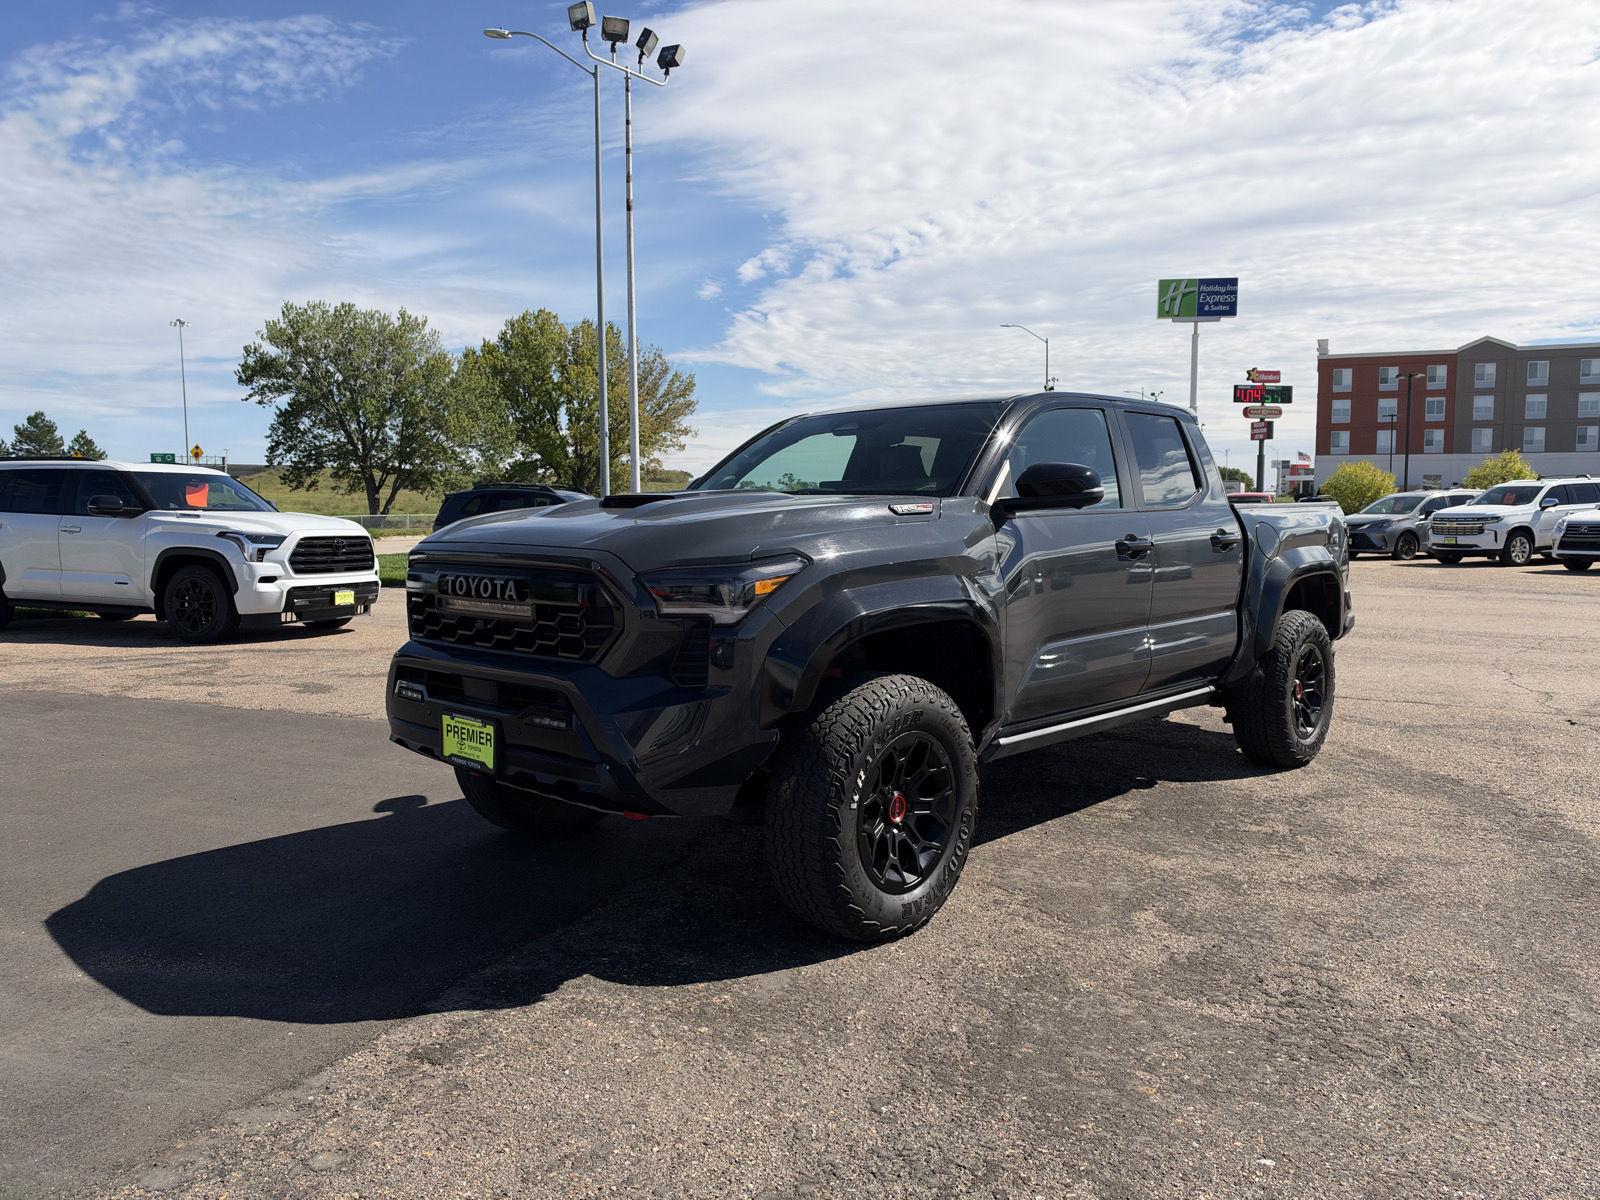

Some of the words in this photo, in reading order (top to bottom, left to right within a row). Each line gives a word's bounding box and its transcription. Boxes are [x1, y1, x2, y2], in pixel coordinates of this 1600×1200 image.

[1200, 284, 1226, 293] Holiday
[1200, 293, 1236, 304] Express
[446, 576, 518, 601] TOYOTA
[446, 723, 493, 748] PREMIER
[467, 744, 482, 752] TOYOTA
[900, 806, 972, 919] GOODYEAR
